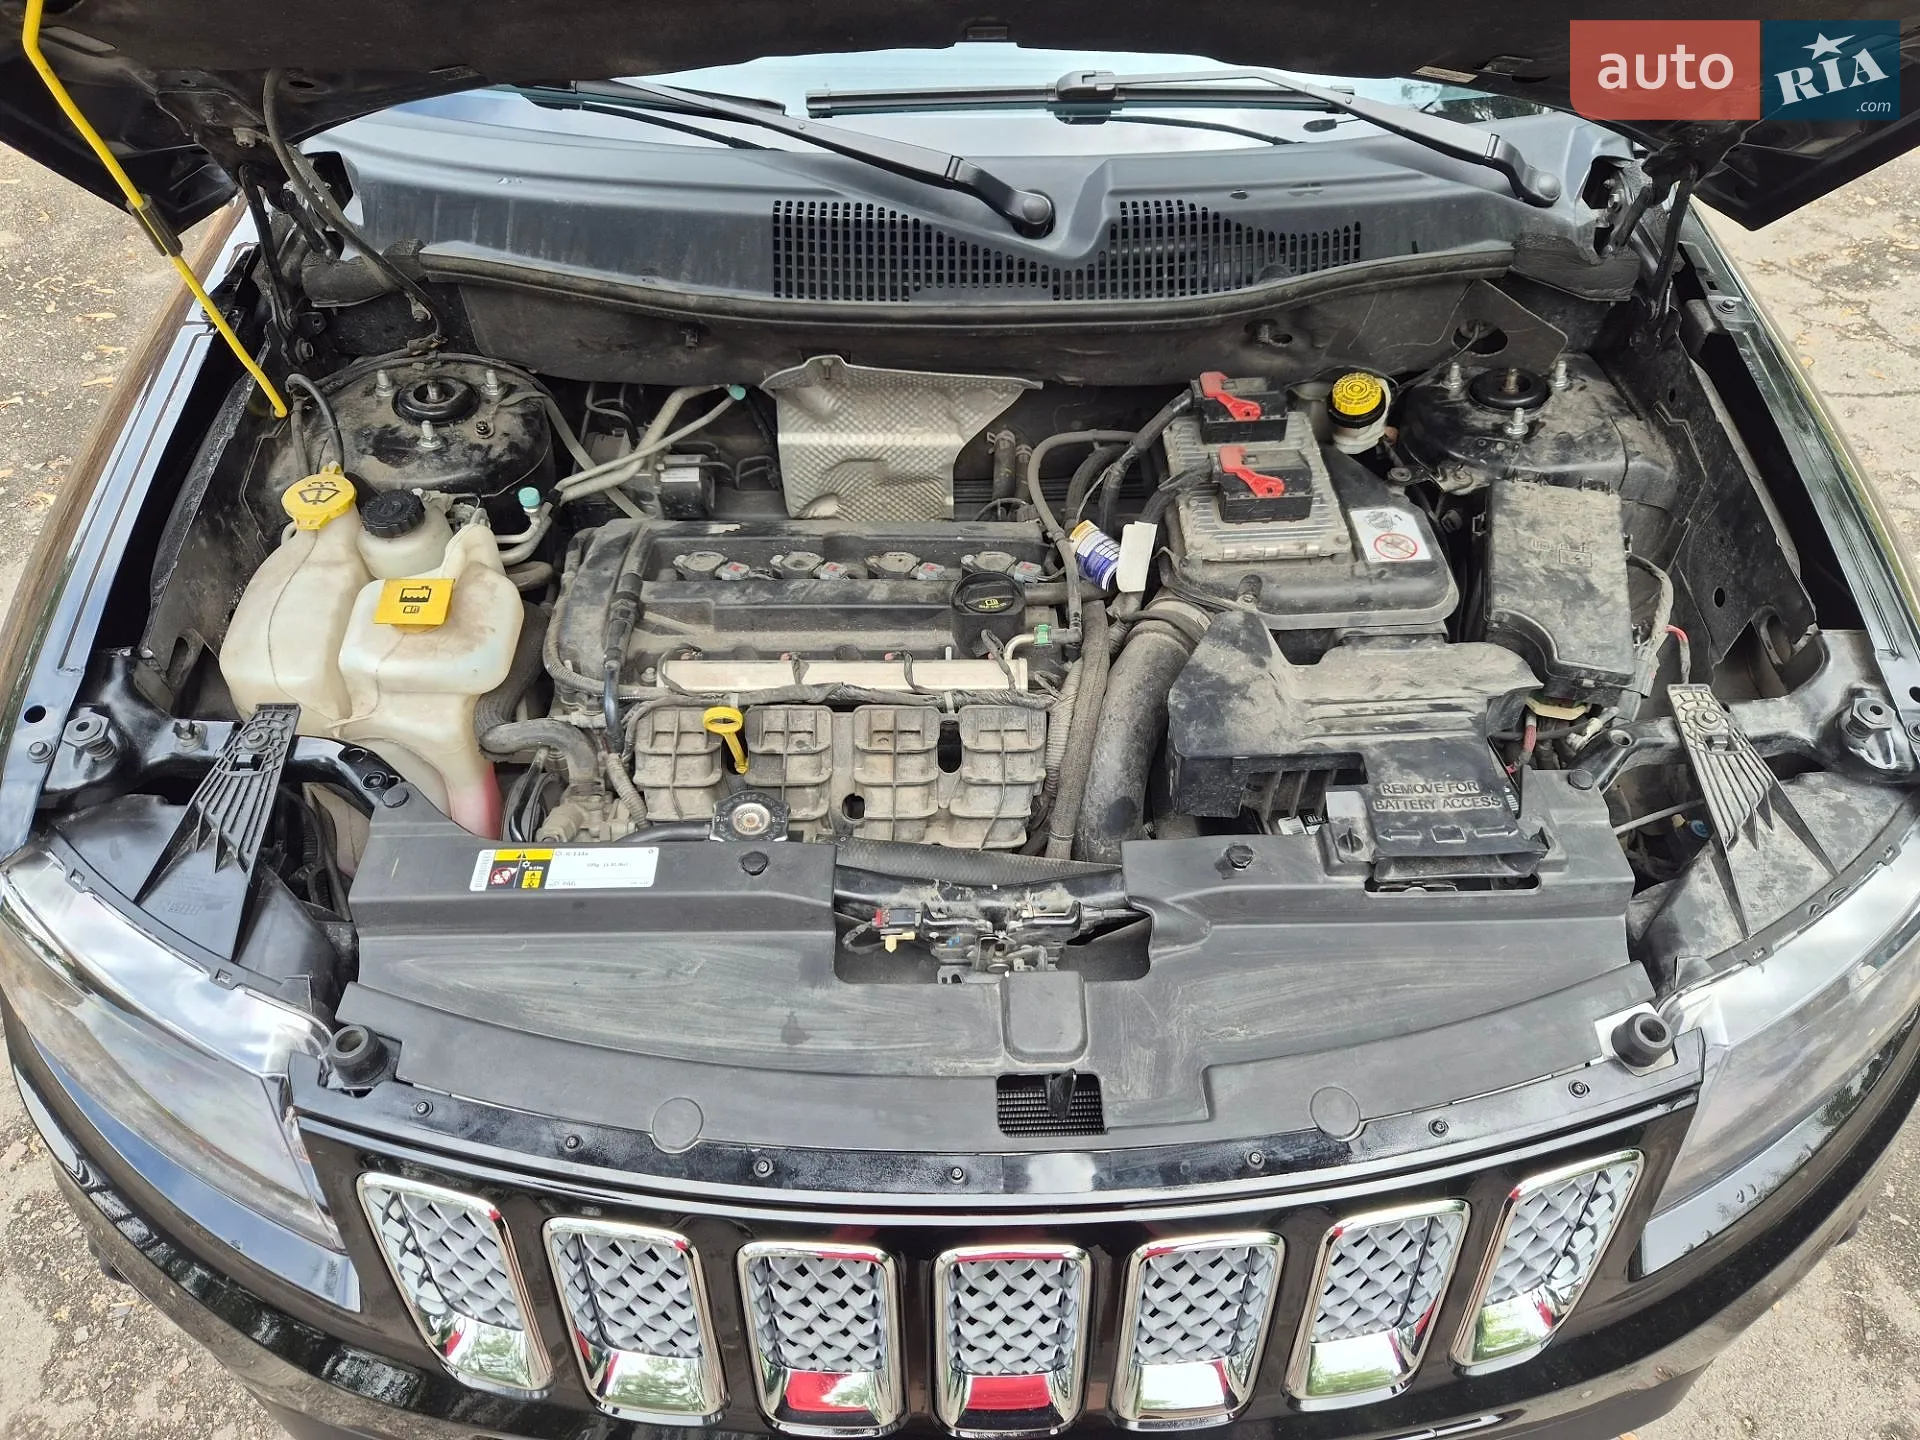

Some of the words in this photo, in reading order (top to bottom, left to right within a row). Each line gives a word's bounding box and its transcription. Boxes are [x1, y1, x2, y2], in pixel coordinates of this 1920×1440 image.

[1381, 783, 1445, 795] REMOVE
[1446, 781, 1480, 793] FOR
[1374, 798, 1437, 811] BATTERY
[1442, 796, 1502, 809] ACCESS
